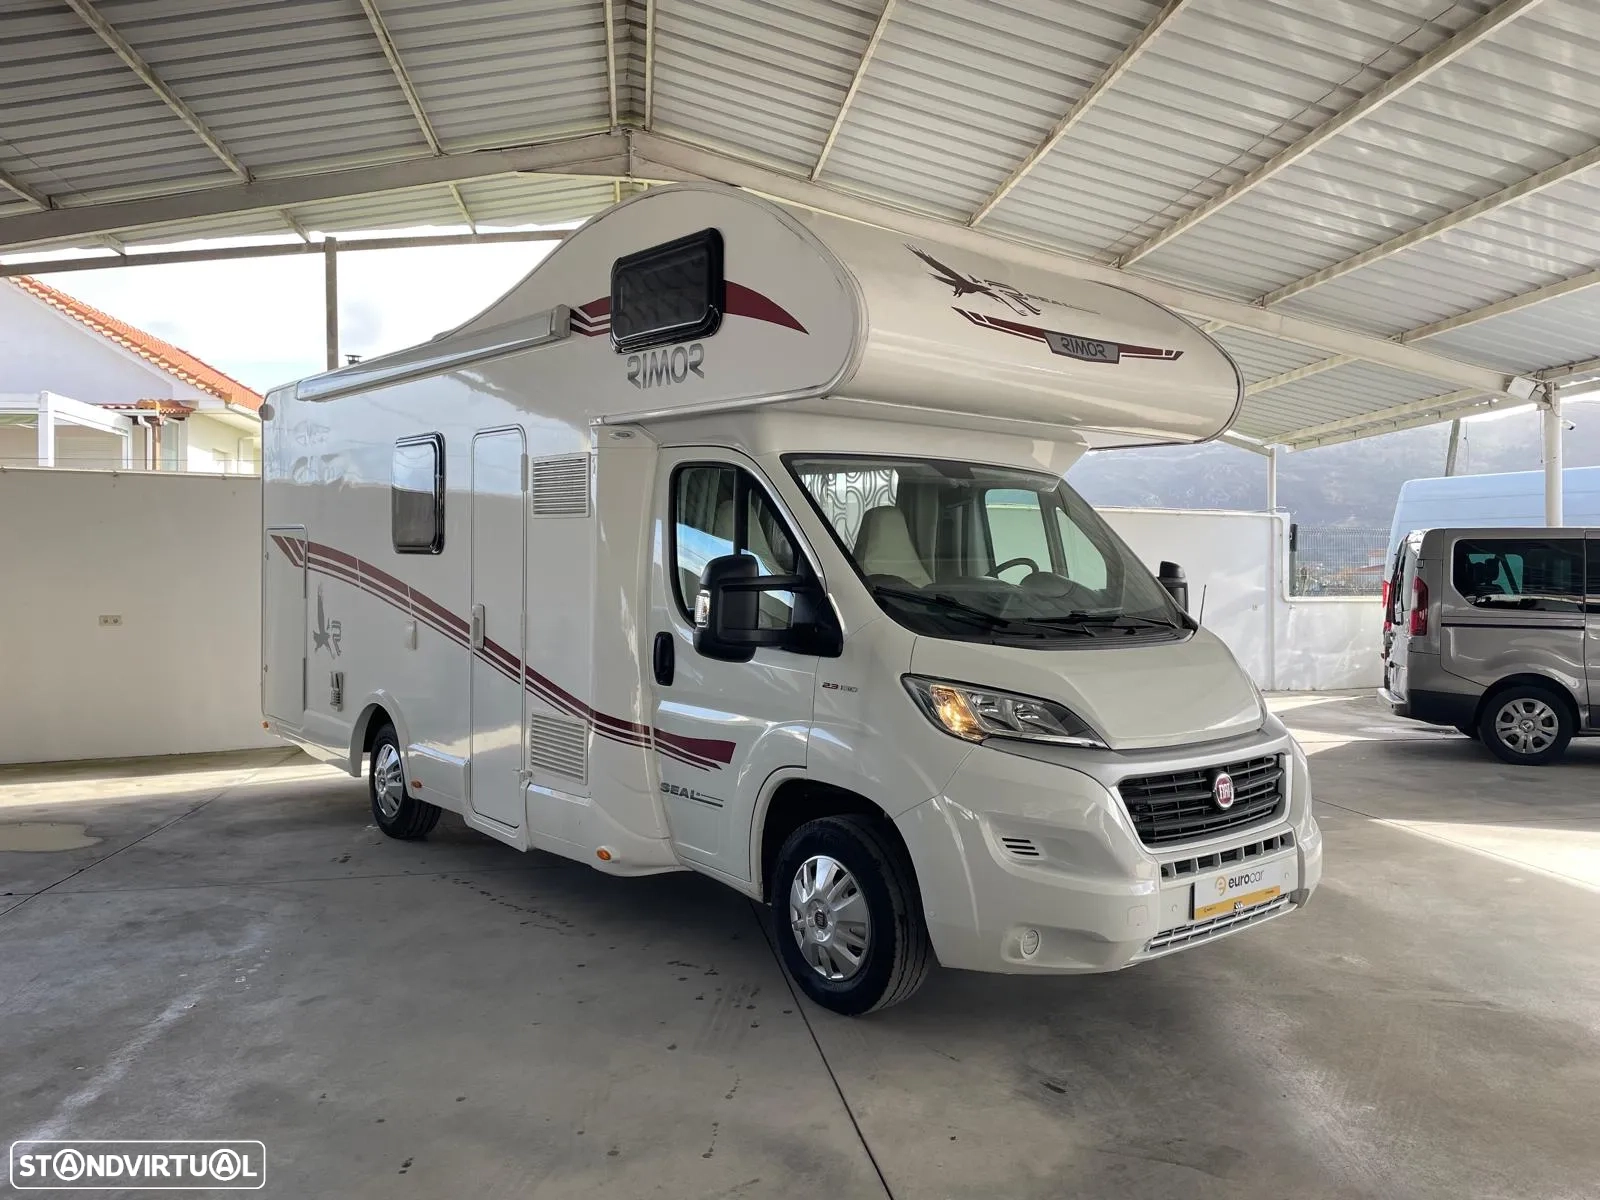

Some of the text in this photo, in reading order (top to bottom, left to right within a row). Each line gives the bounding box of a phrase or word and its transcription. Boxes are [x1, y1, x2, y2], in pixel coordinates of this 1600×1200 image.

[1061, 337, 1107, 359] RIMOR
[627, 343, 704, 390] RIMOR
[660, 782, 695, 800] SEAL
[1228, 870, 1264, 889] eurocar
